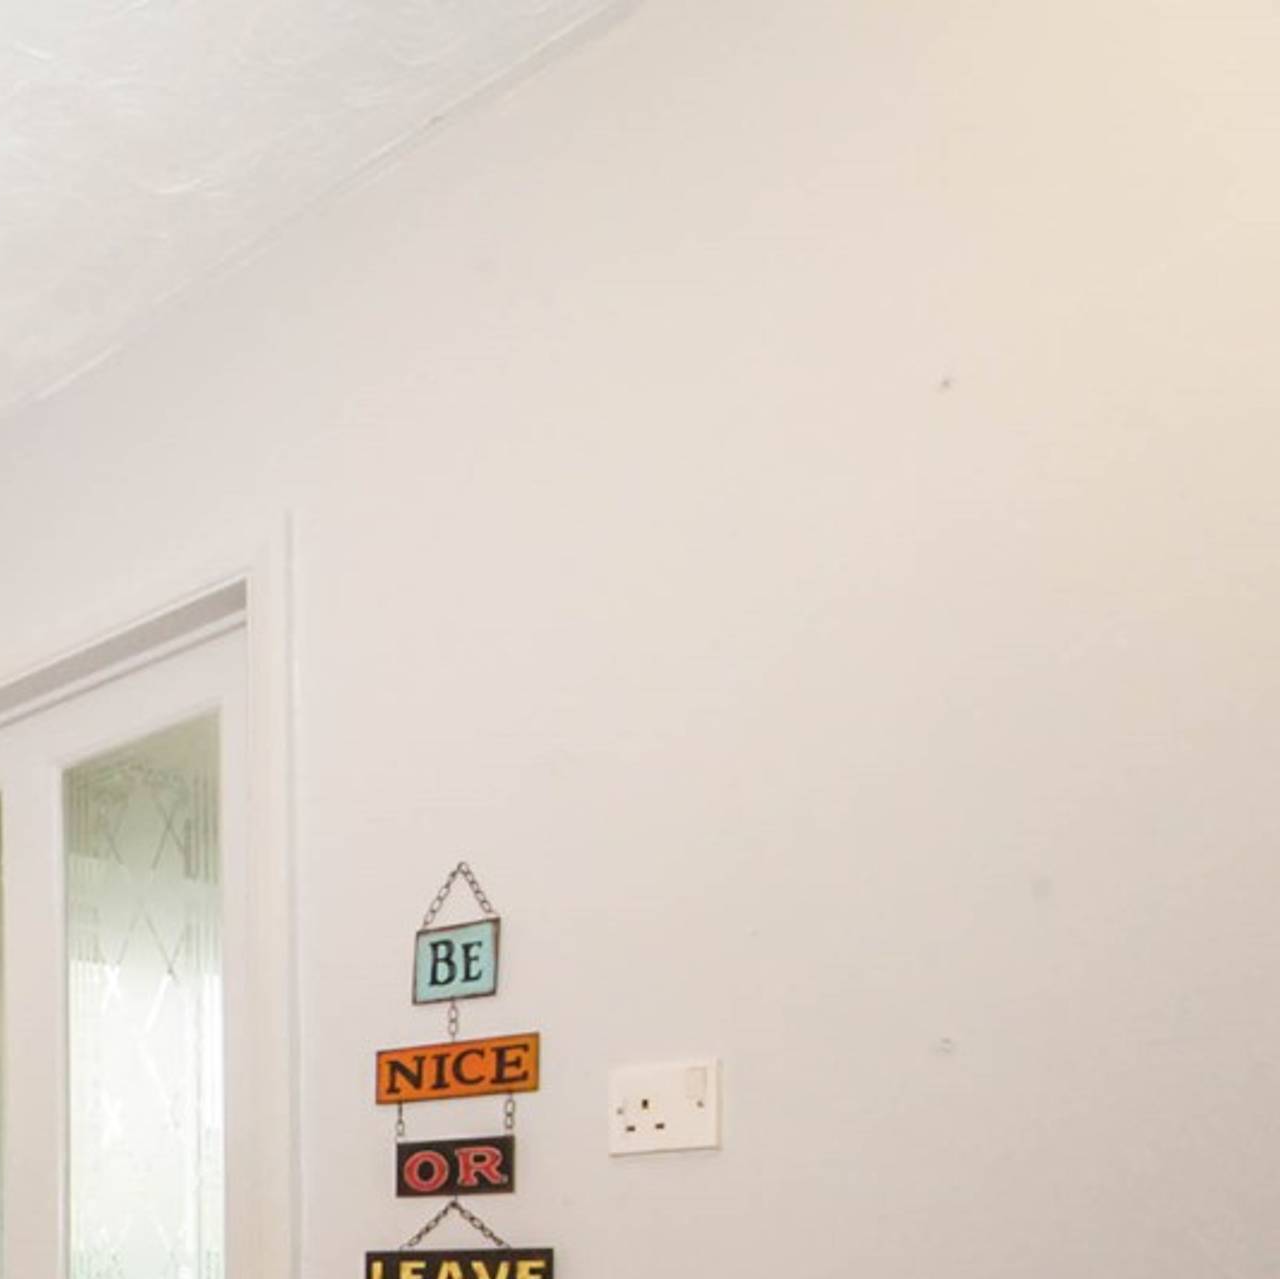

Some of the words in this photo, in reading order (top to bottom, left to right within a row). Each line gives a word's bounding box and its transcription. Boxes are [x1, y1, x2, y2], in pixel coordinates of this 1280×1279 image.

[428, 938, 483, 987] BE
[386, 1043, 530, 1095] NICE
[404, 1145, 508, 1192] OR
